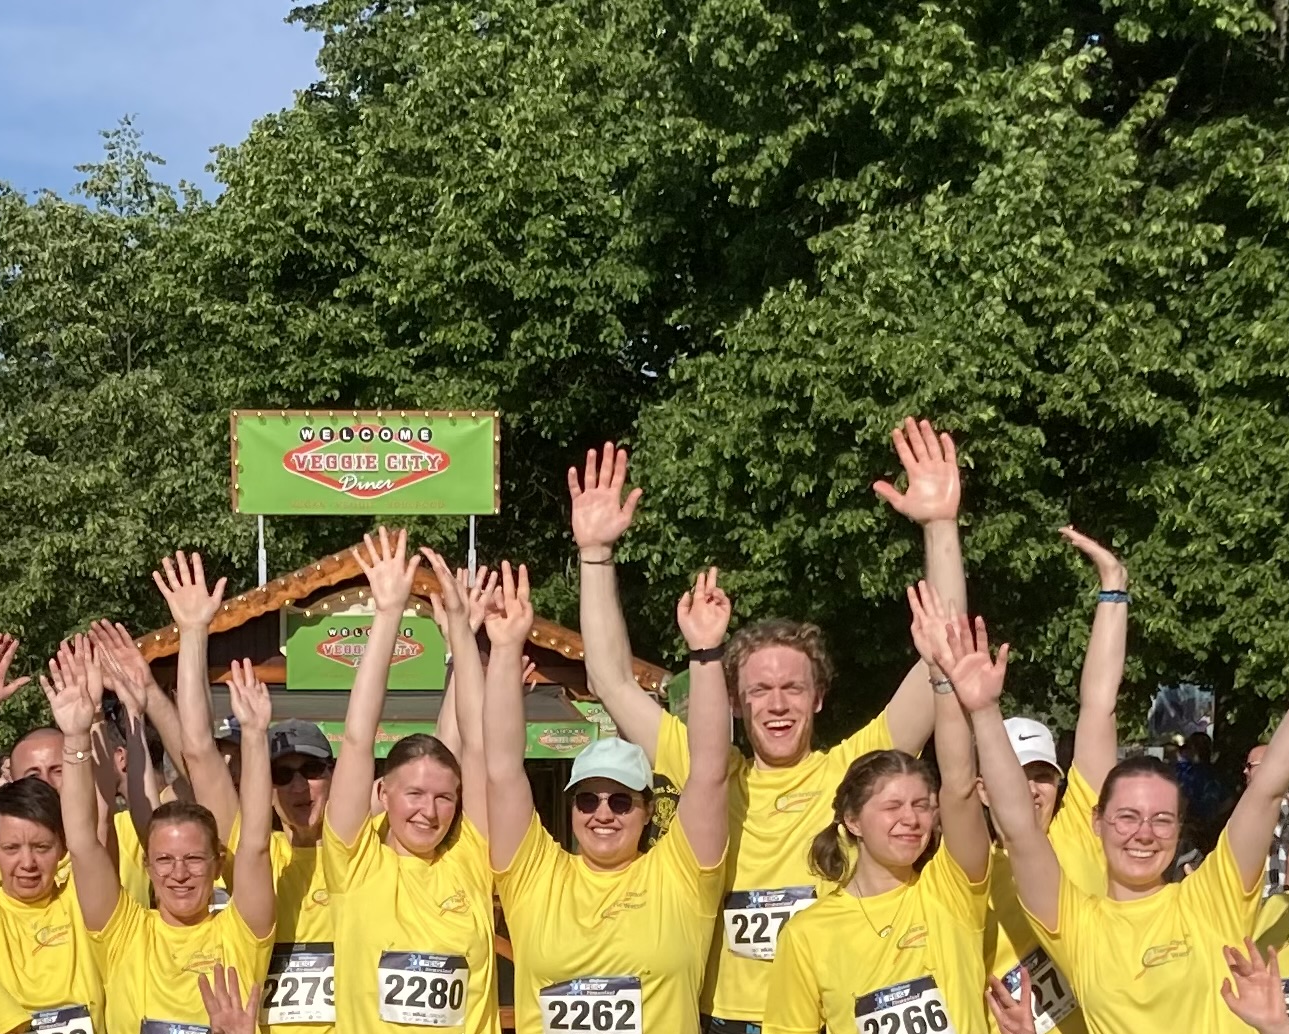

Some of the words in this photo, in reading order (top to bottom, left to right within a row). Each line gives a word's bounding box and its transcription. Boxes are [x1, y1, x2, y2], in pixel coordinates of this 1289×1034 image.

[300, 428, 431, 442] WELCOME
[293, 453, 378, 471] VEGGIE
[386, 453, 443, 471] CITY
[338, 473, 394, 491] Diner
[732, 911, 791, 944] 227
[384, 973, 464, 1011] 2280
[548, 999, 636, 1032] 2262
